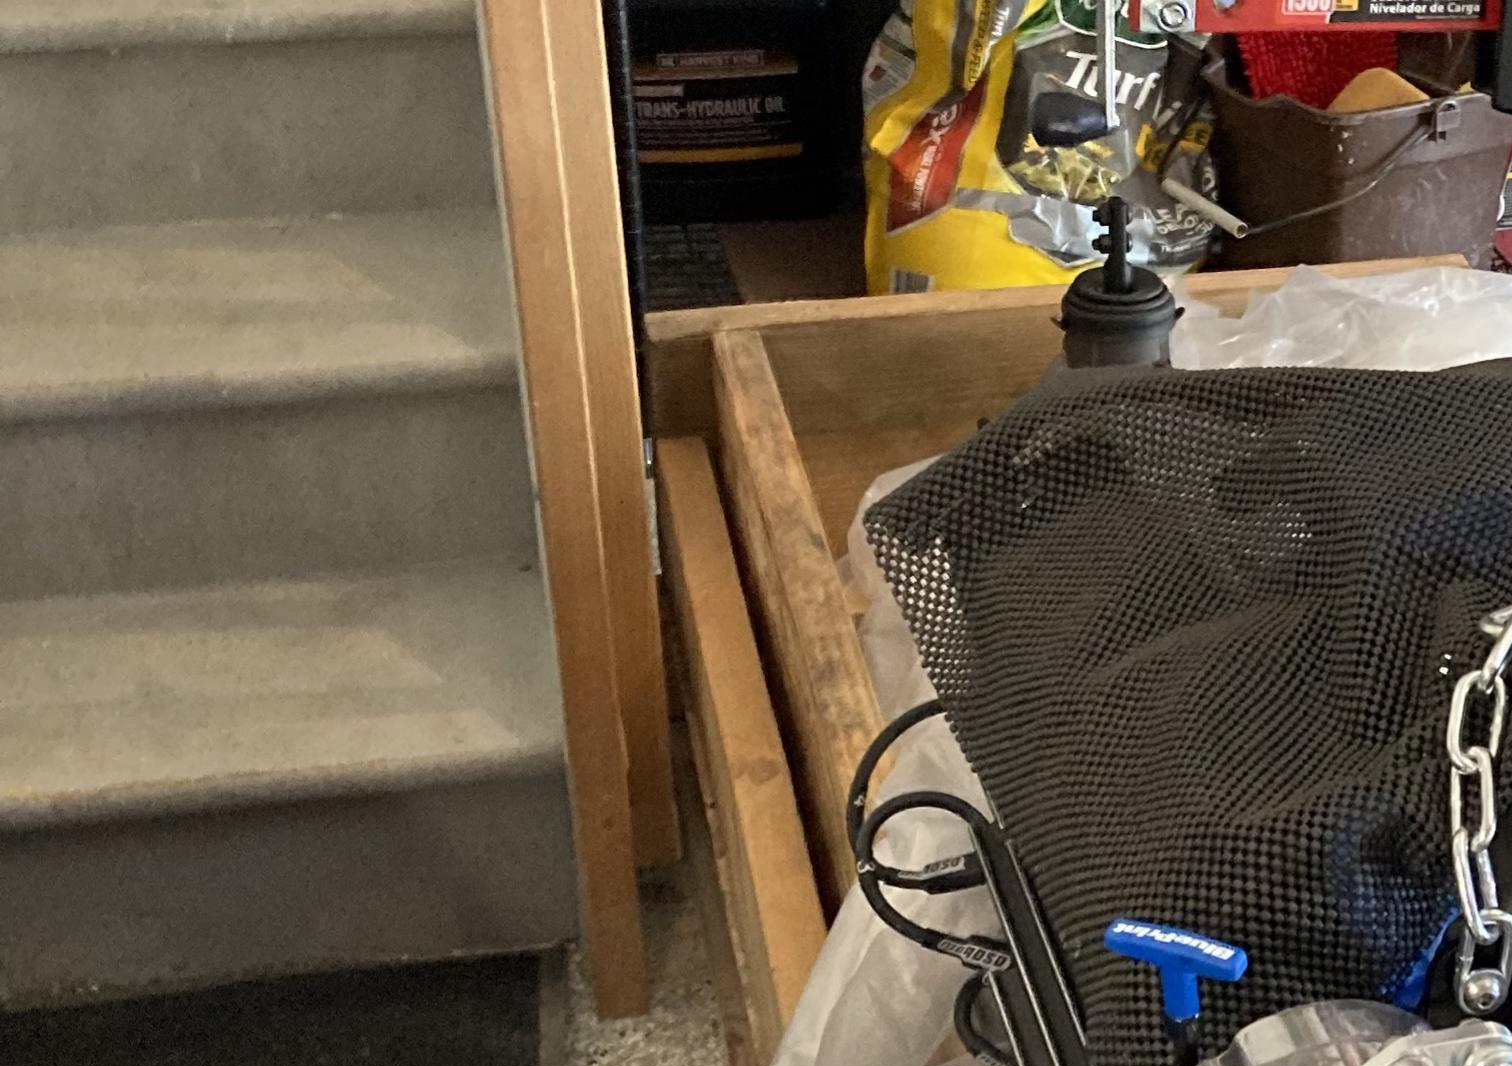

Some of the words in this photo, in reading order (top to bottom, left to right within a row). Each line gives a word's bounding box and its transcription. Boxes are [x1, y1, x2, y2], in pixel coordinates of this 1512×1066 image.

[1369, 3, 1427, 14] Nivelador
[1430, 3, 1444, 13] de
[1447, 2, 1480, 14] Carga
[1065, 51, 1160, 111] Turf
[1113, 923, 1235, 960] BluePrint
